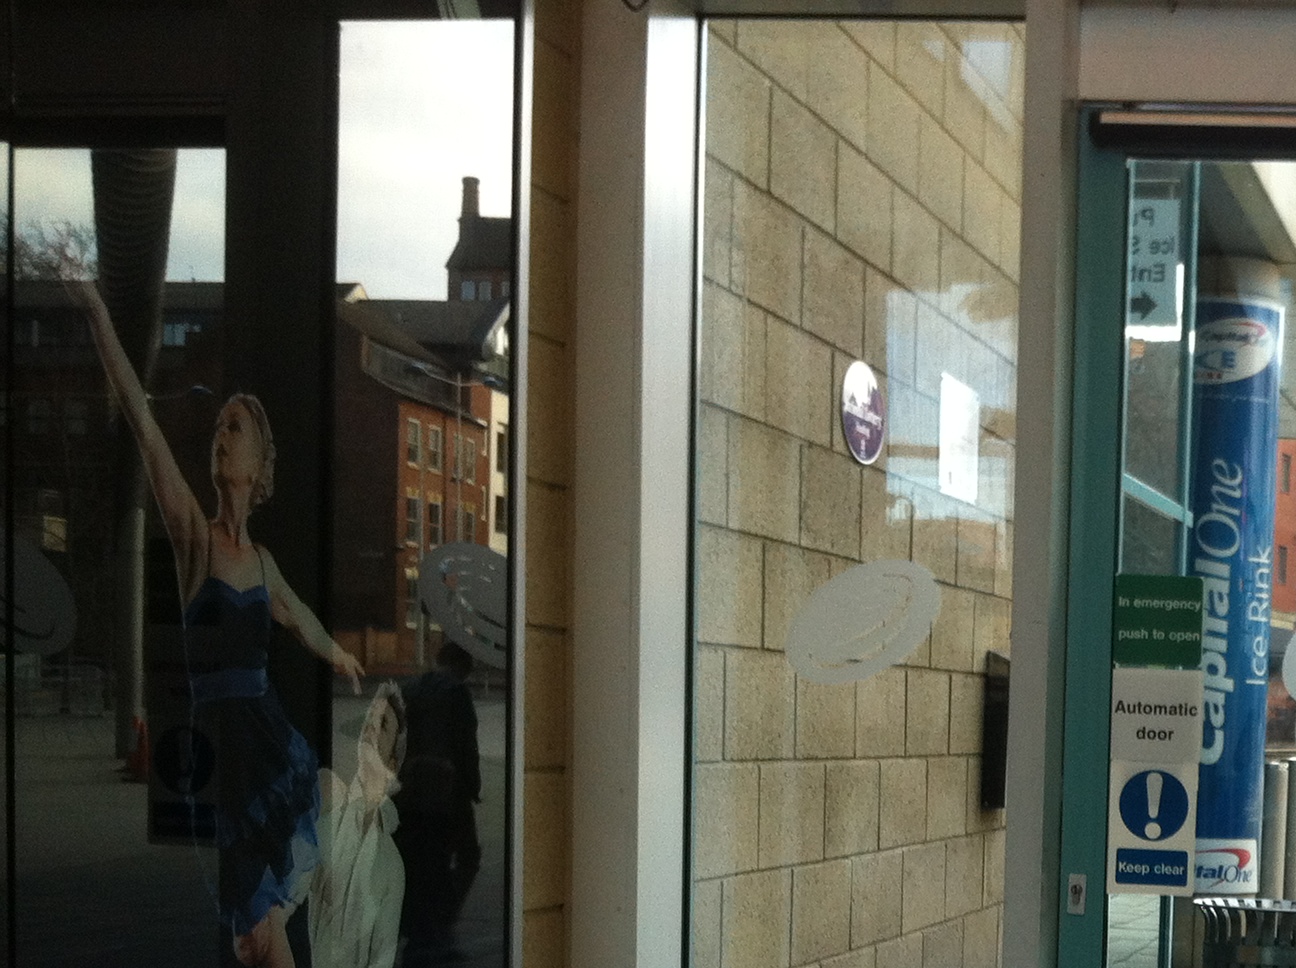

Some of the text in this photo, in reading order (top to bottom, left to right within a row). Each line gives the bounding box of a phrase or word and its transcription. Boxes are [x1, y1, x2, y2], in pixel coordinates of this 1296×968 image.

[1118, 596, 1201, 613] In emergency
[1246, 546, 1272, 685] Ice Rink
[1118, 628, 1200, 643] push to open
[1115, 700, 1198, 717] Automatic
[1136, 726, 1175, 741] door
[1118, 861, 1185, 875] Keep clear
